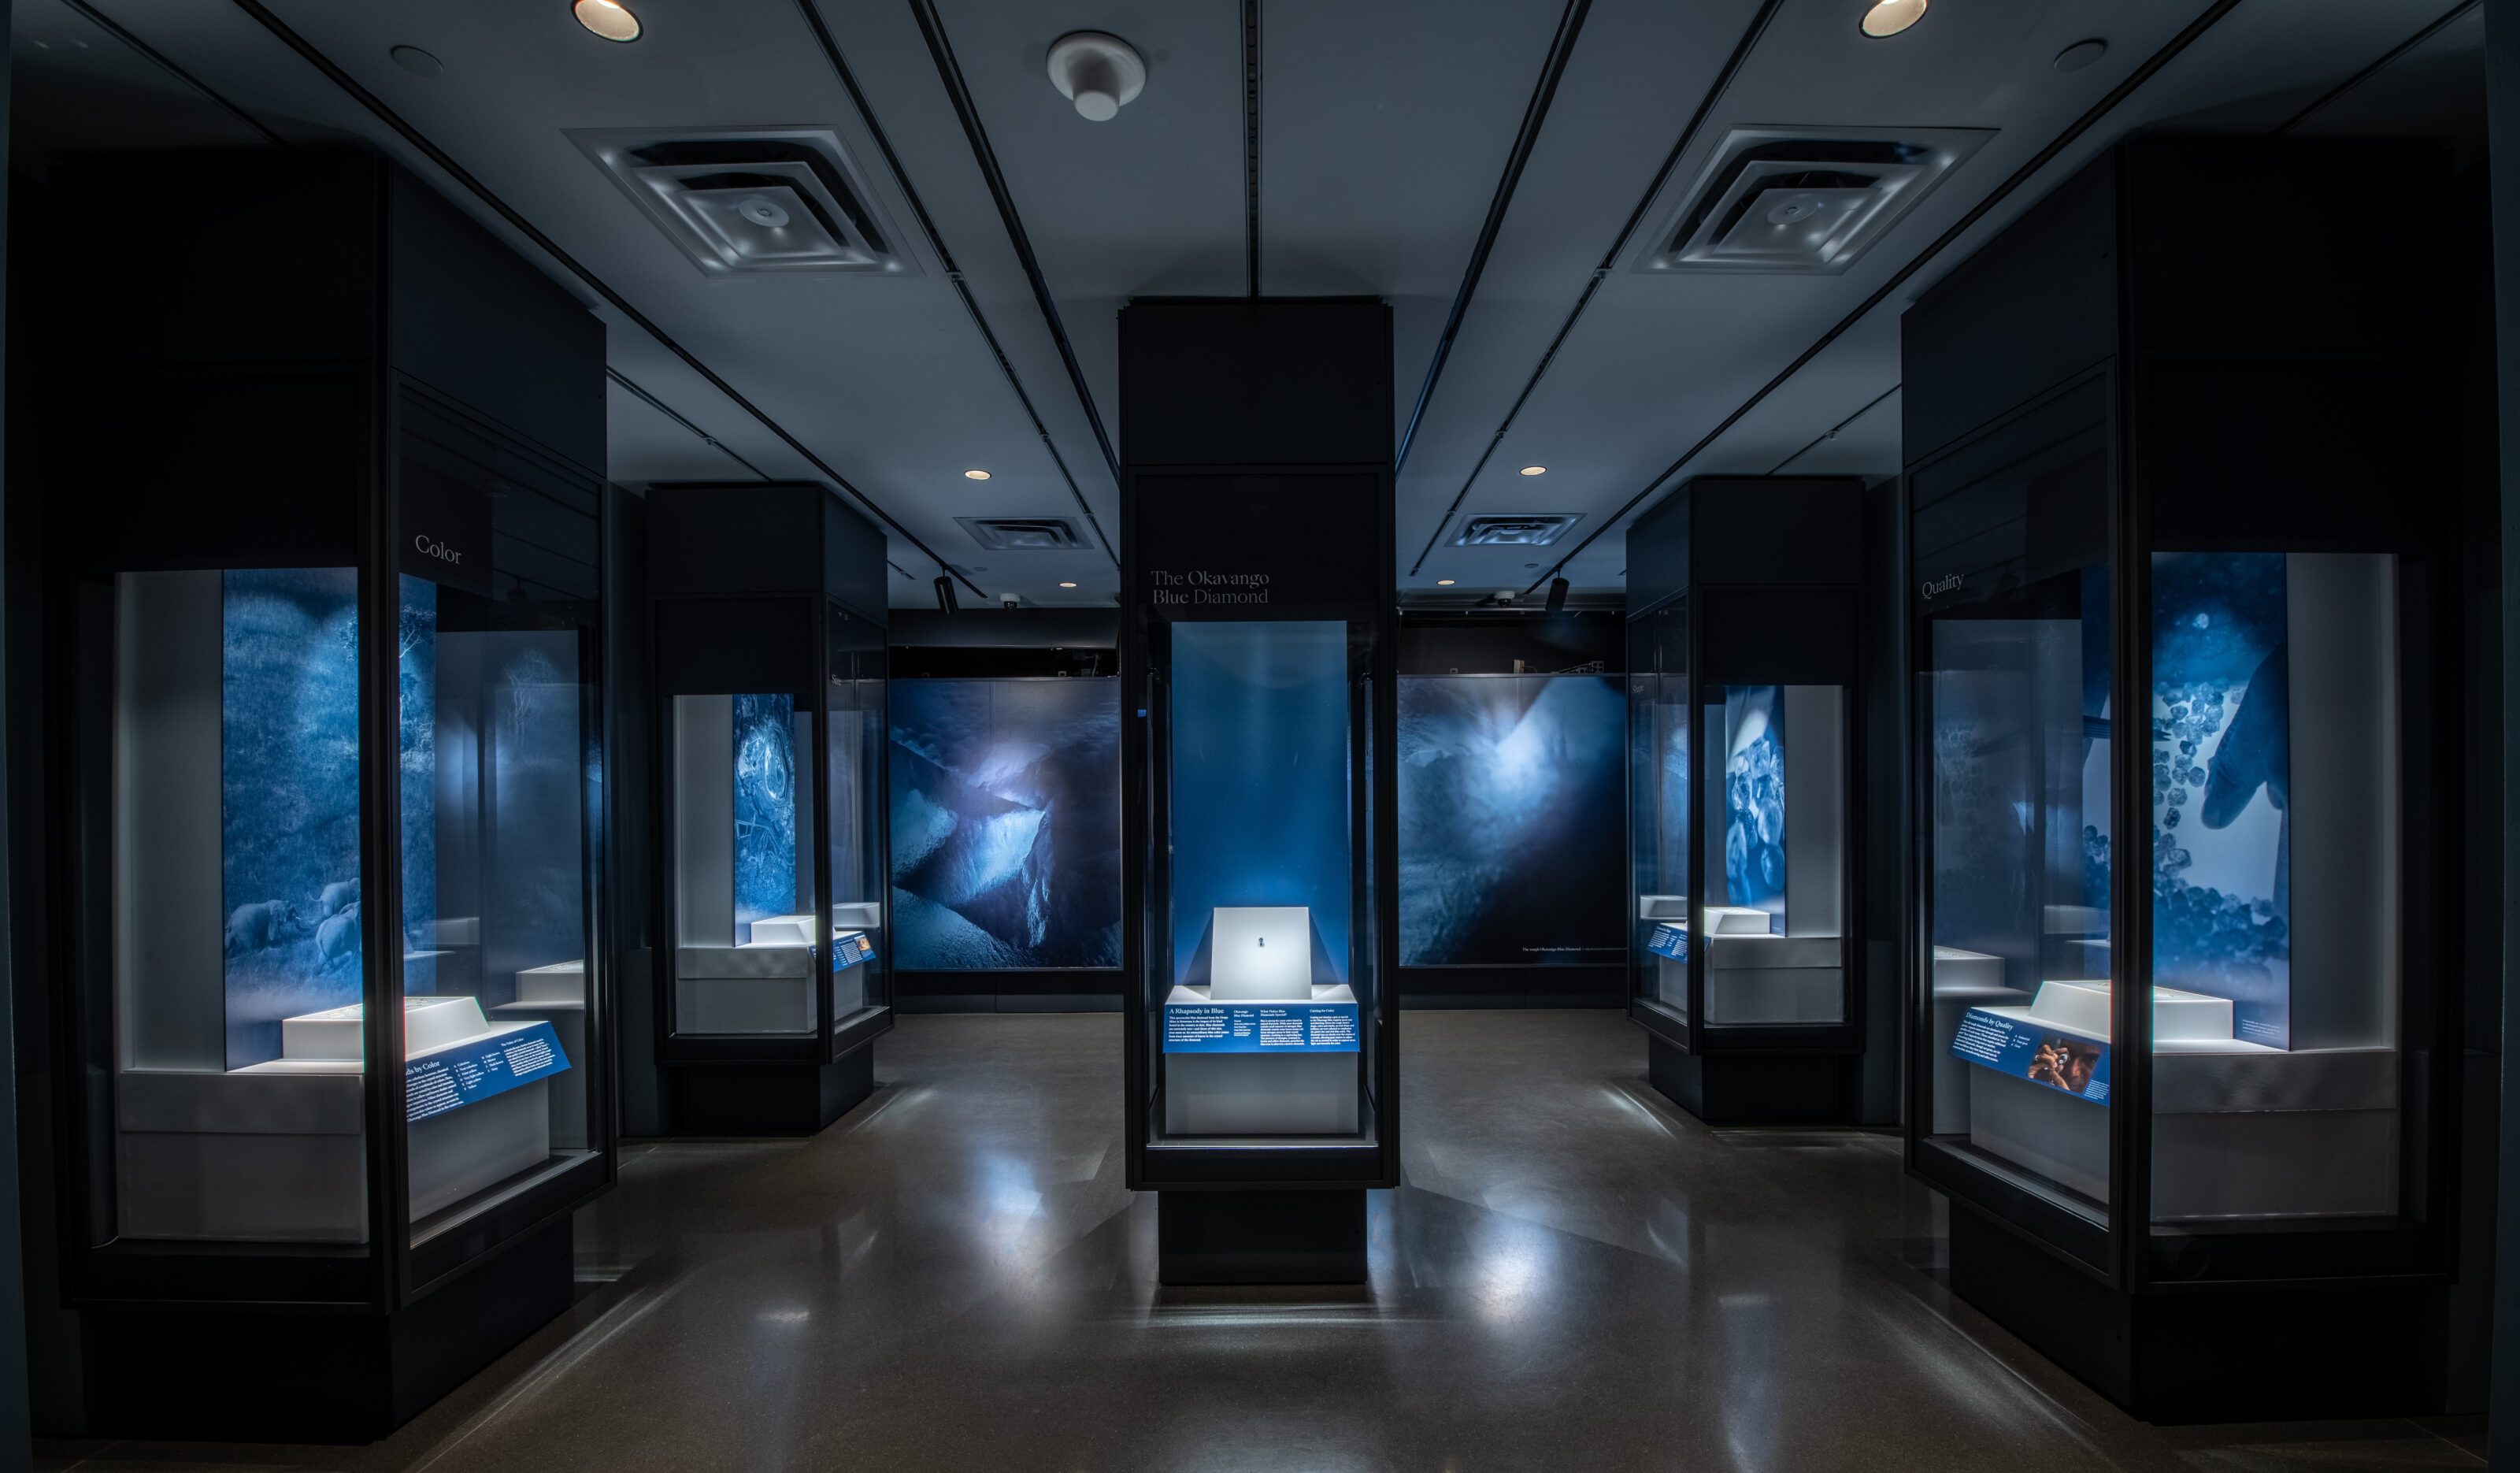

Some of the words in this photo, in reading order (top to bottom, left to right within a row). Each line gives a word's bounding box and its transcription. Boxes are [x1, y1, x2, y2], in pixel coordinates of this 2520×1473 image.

[415, 535, 461, 564] Color
[1151, 570, 1184, 585] The
[1188, 570, 1269, 589] Okavango
[1922, 573, 1965, 599] Quality
[1154, 589, 1189, 604] Blue
[1195, 588, 1268, 604] Diamond
[1966, 1012, 1988, 1023] Diamonds
[1995, 1021, 2014, 1031] Quality
[422, 1061, 440, 1070] Color
